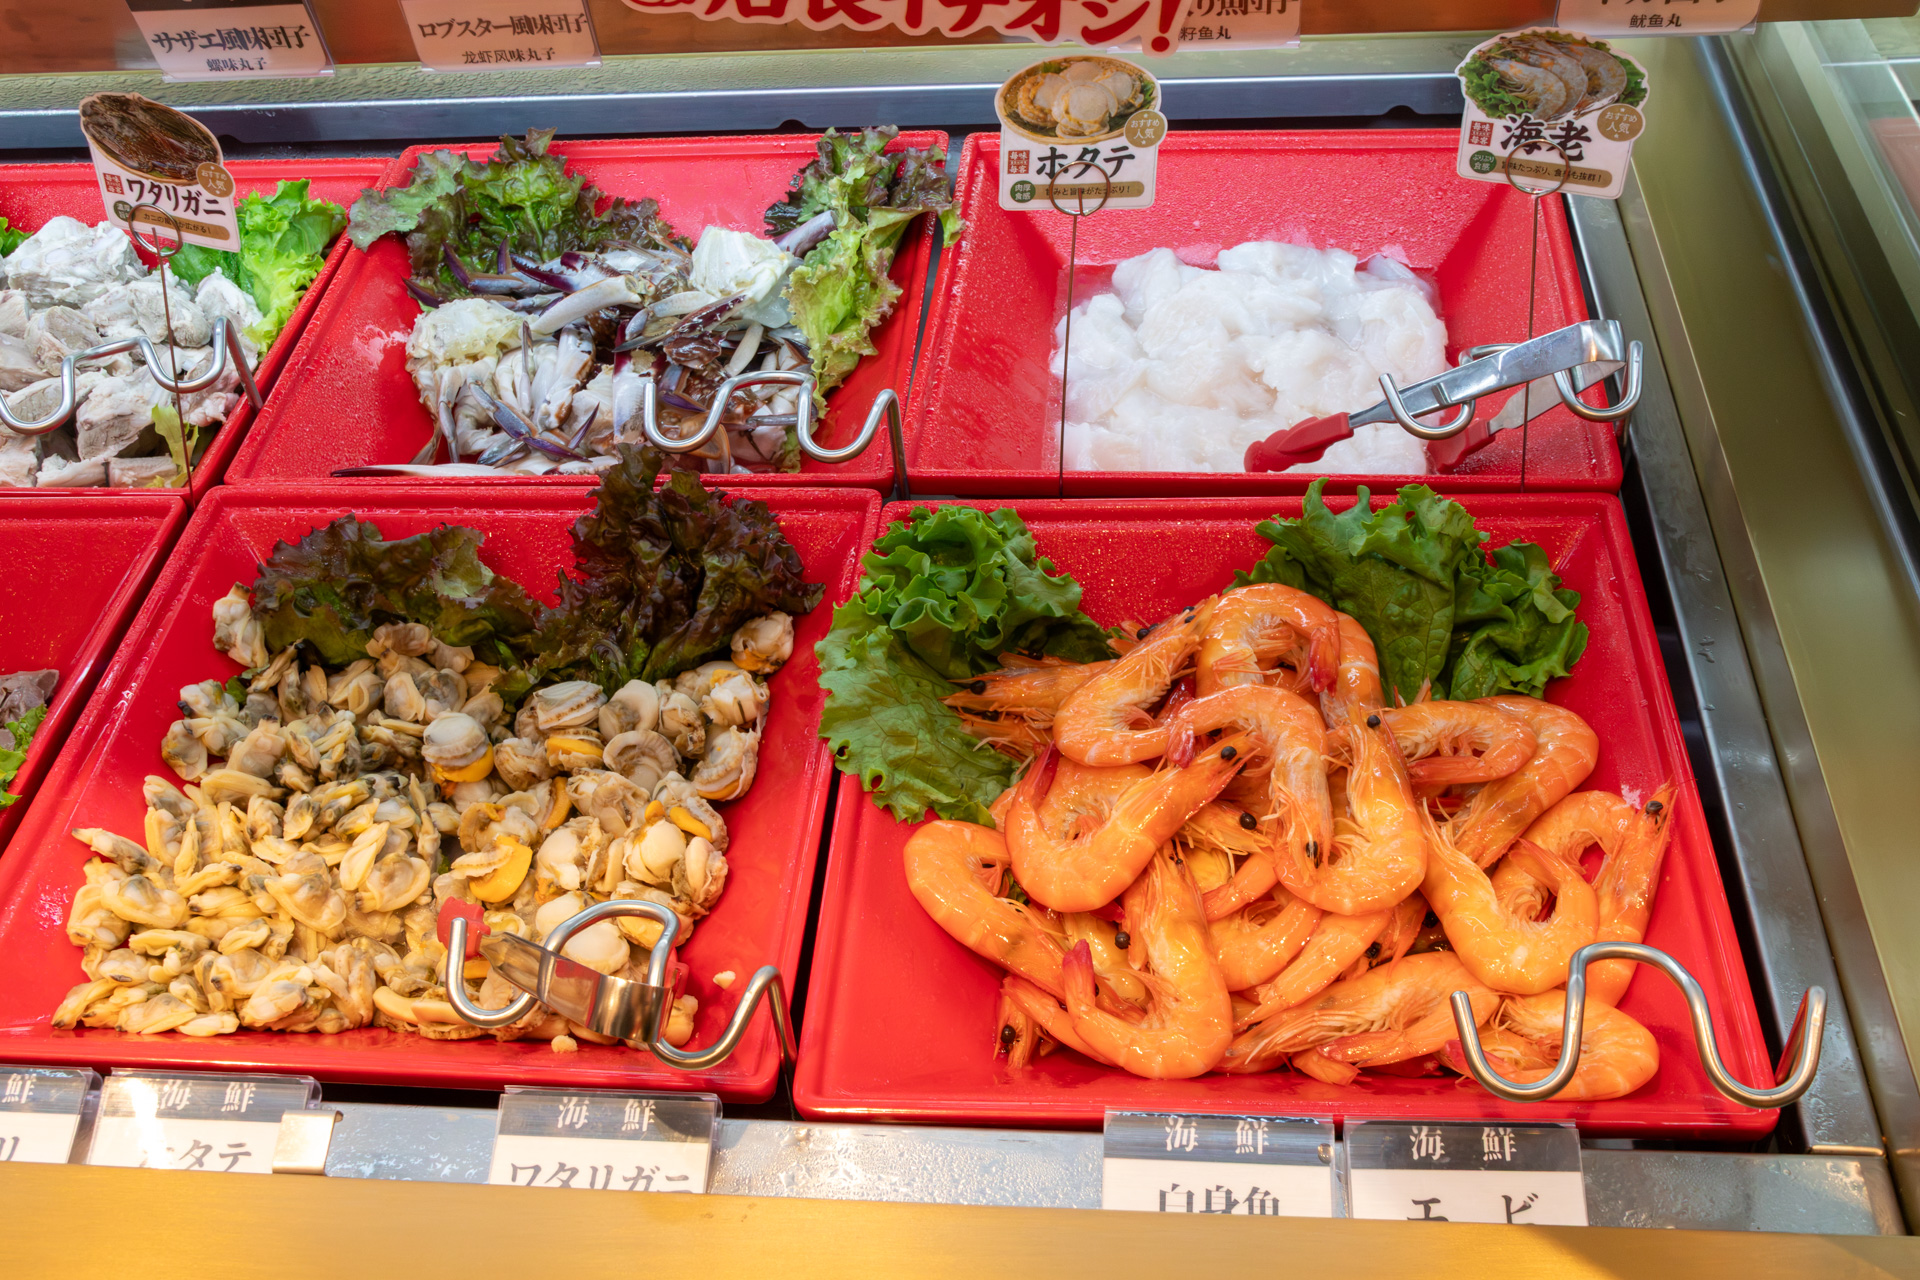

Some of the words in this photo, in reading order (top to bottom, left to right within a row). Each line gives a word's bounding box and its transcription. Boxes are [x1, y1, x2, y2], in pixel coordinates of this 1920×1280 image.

[417, 13, 589, 39] ロブスター風味団子
[1629, 13, 1682, 28] 鱿鱼丸
[152, 25, 311, 53] サザエ風味団子
[462, 47, 556, 65] 龙虾风味丸子
[1131, 119, 1160, 129] おすすめ
[1604, 111, 1638, 123] おすすめ
[1606, 122, 1630, 135] 人気
[1133, 128, 1155, 140] 人気
[1500, 114, 1592, 162] 海老
[1036, 145, 1136, 180] ホタテ
[126, 178, 226, 216] ワタリガニ
[207, 180, 227, 192] 人気
[557, 1097, 656, 1132] 海鮮
[1165, 1116, 1270, 1155] 海鮮
[1409, 1125, 1518, 1162] 海鮮
[140, 1139, 252, 1172] タテ
[511, 1161, 694, 1193] ワタリガニ
